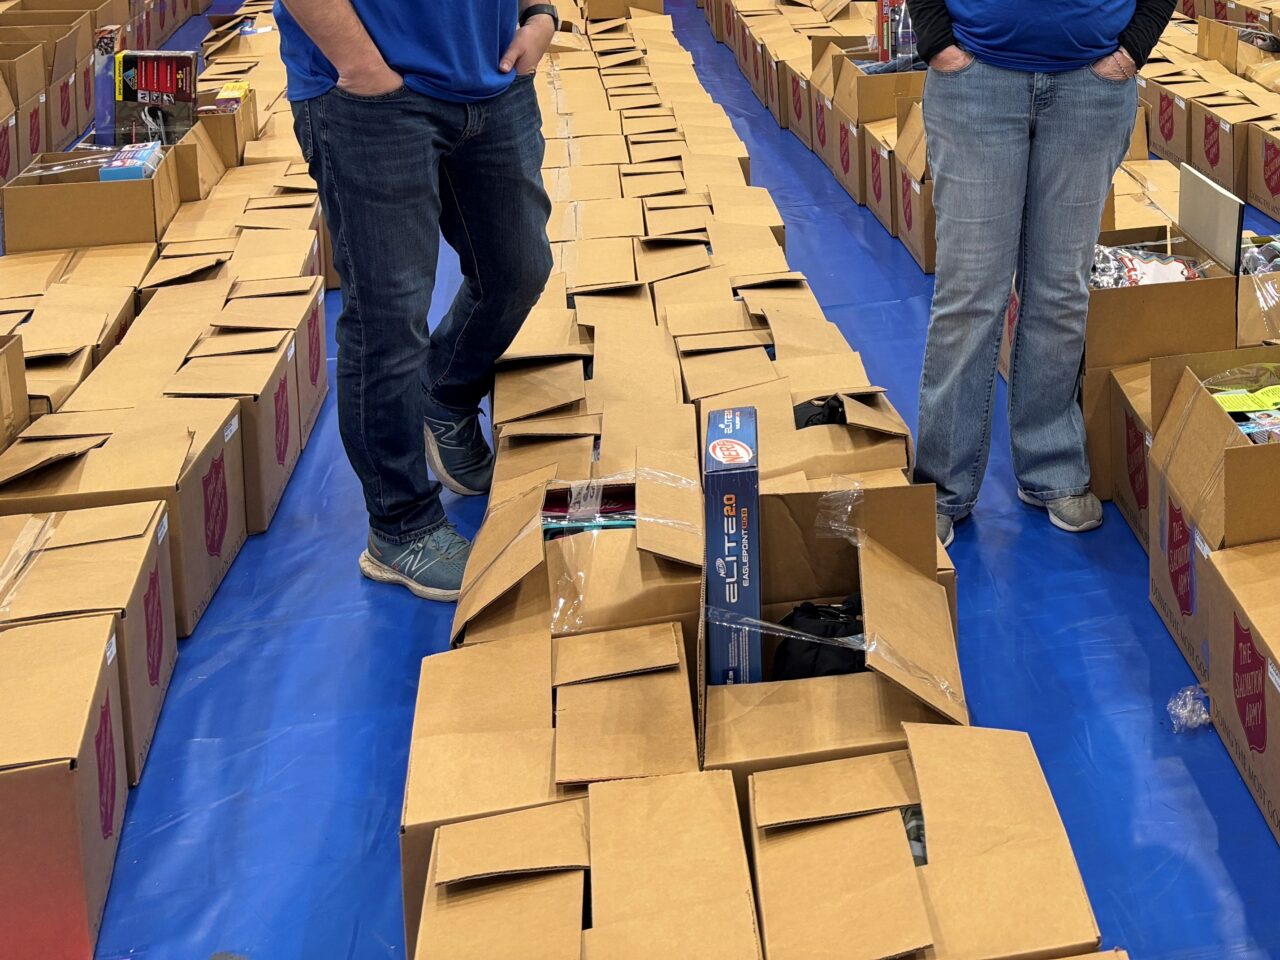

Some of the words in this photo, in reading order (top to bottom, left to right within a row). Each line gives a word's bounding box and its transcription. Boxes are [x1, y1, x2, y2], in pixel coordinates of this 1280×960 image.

[717, 440, 744, 464] NERF
[724, 494, 737, 516] 2.0
[1172, 520, 1183, 543] THE
[724, 517, 738, 603] ELITE
[741, 528, 750, 587] EAGLEPOINT
[1177, 572, 1190, 598] ARMY
[1239, 642, 1252, 665] THE
[1235, 667, 1264, 698] SALVATION
[1245, 700, 1262, 730] ARMY
[1213, 702, 1235, 750] DOING
[1234, 744, 1247, 767] THE
[1248, 764, 1267, 802] MOST
